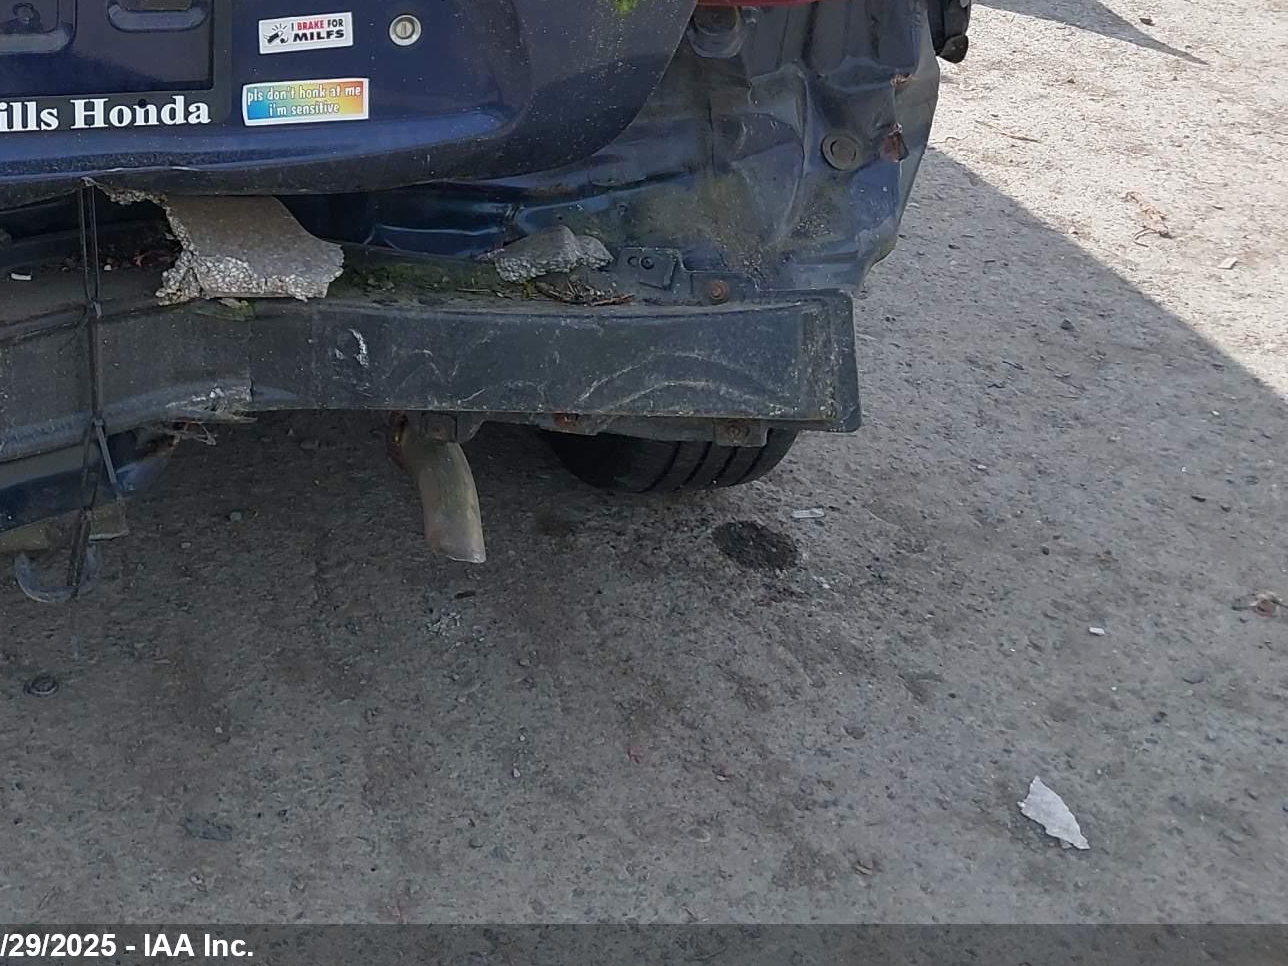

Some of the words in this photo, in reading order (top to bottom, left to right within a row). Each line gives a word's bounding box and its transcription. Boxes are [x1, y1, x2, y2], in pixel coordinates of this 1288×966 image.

[297, 19, 325, 31] BRAKE
[327, 18, 344, 29] FOR
[293, 29, 345, 43] MILFS
[247, 88, 263, 106] pls
[267, 86, 296, 101] don't
[299, 85, 327, 99] honk
[329, 86, 341, 97] at
[345, 86, 361, 97] me
[70, 95, 212, 130] Honda
[268, 102, 287, 117] i'm
[291, 100, 340, 116] sensitive
